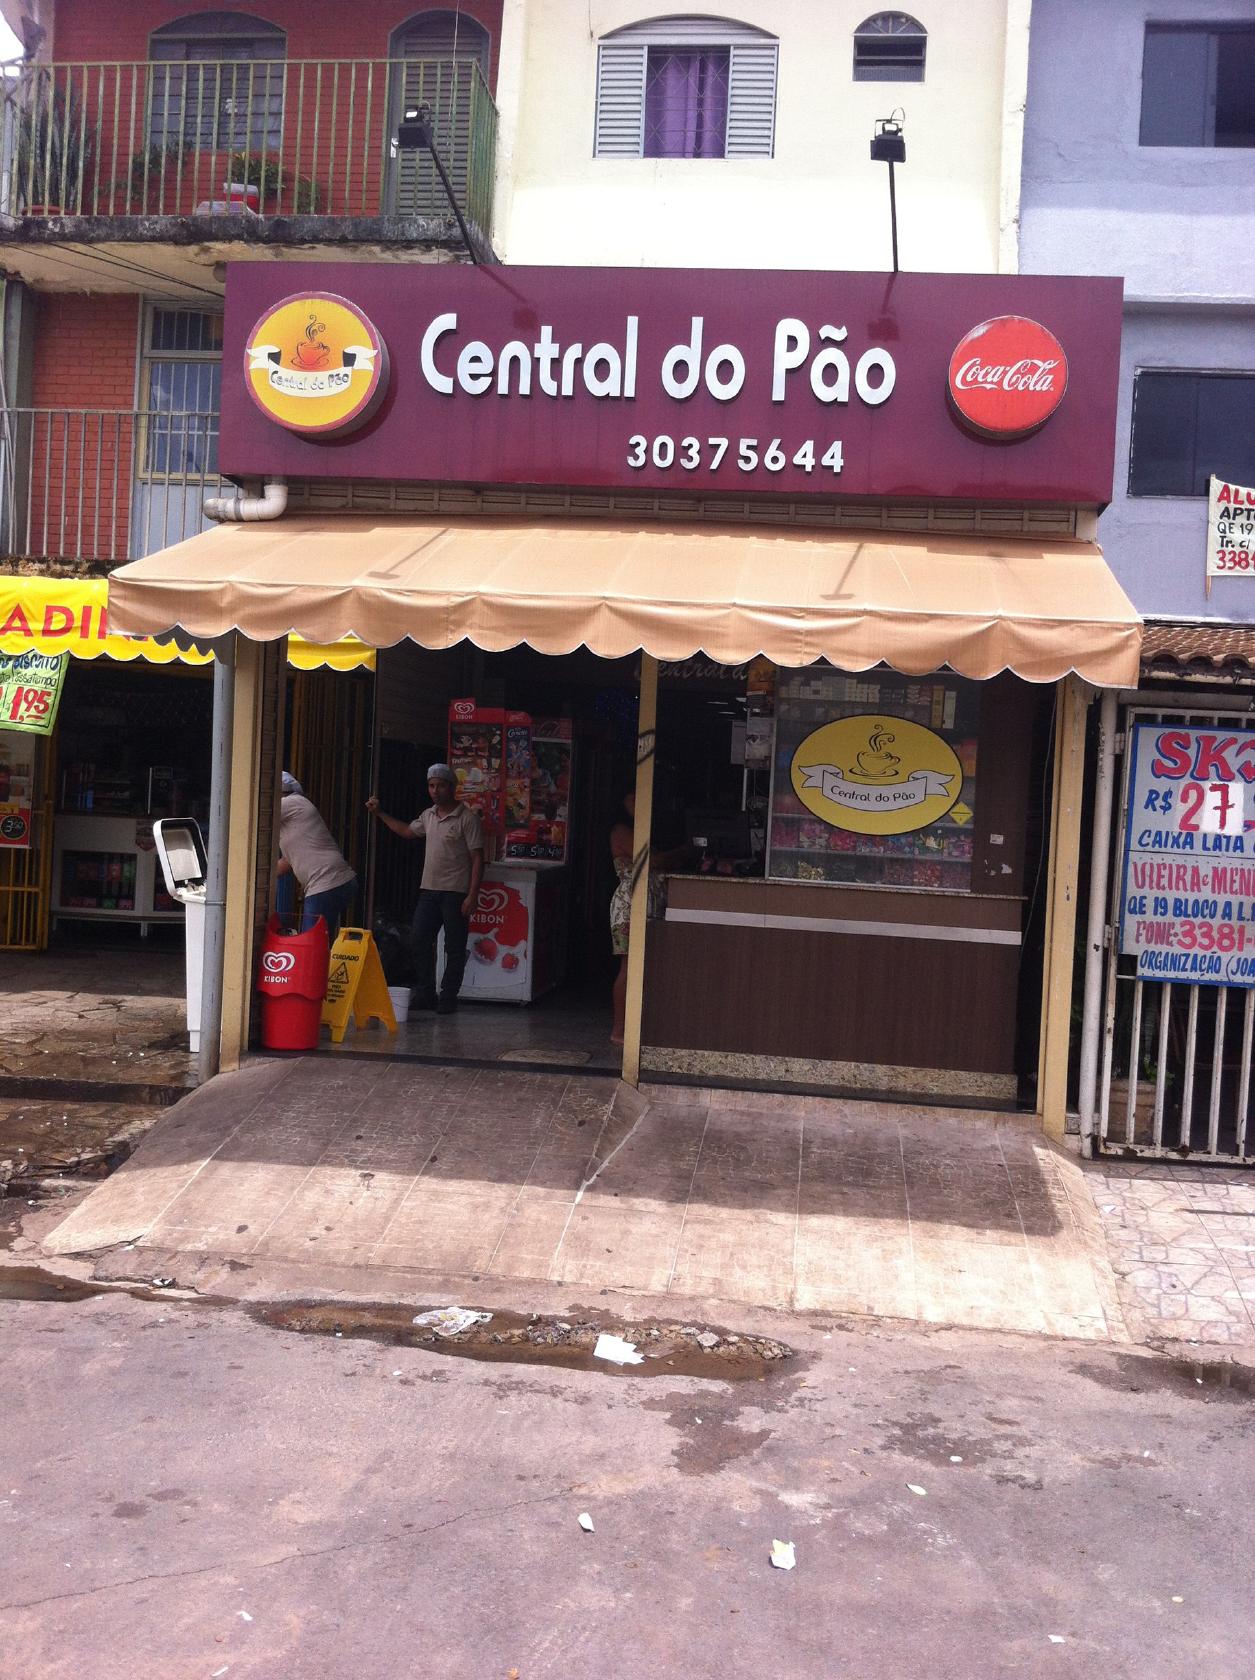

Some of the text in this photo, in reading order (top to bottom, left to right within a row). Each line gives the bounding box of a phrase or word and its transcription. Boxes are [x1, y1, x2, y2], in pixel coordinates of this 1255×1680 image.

[421, 313, 897, 404] Central do Pão
[270, 370, 307, 391] Central
[954, 357, 1060, 391] Coca-Cola
[626, 435, 845, 473] 30375644
[1217, 521, 1253, 535] QE 19
[830, 785, 916, 803] Central do Pão
[1143, 787, 1173, 815] R$
[1138, 829, 1244, 853] CAIXA LATA
[1132, 861, 1201, 893] VIEIRA
[1211, 865, 1255, 898] MEN
[470, 914, 505, 924] KIBON
[1127, 895, 1147, 916] QE
[1153, 896, 1168, 916] 19
[1172, 897, 1218, 919] BLOCO
[1221, 900, 1233, 921] A
[332, 953, 360, 962] CUIDADO
[1140, 949, 1223, 977] ORGANIZAÇÃO
[264, 975, 288, 984] KIBON
